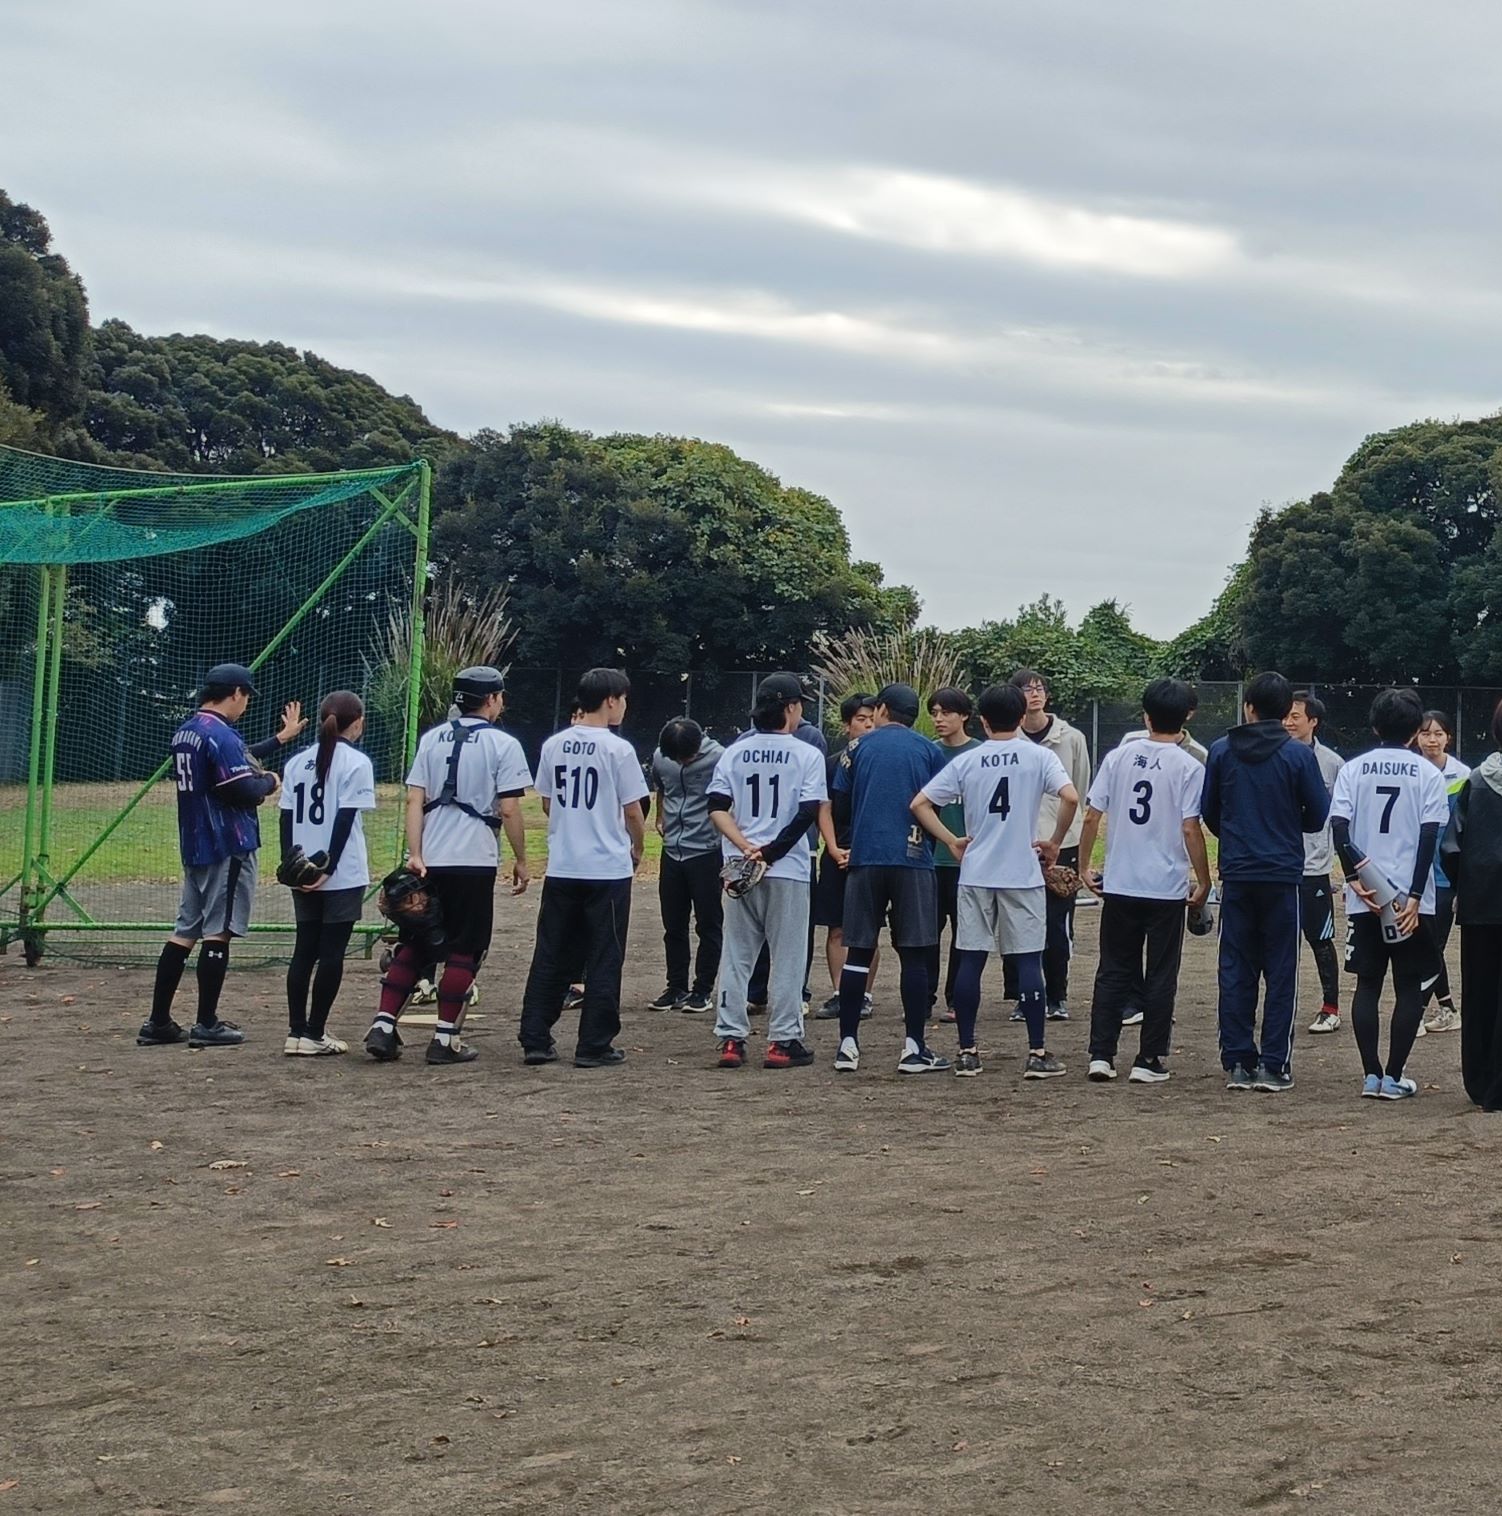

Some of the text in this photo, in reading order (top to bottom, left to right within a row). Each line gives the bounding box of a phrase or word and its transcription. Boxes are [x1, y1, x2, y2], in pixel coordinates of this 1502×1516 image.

[438, 731, 480, 744] KOEI
[562, 740, 596, 756] GOTO
[742, 749, 790, 764] OCHIAI
[981, 752, 1019, 768] KOTA
[1133, 754, 1162, 771] 海人
[1362, 761, 1419, 778] DAISUKE
[555, 765, 599, 811] 510
[746, 773, 779, 819] 11
[988, 776, 1011, 822] 4
[1129, 780, 1153, 825] 3
[293, 782, 325, 826] 18
[1375, 786, 1401, 834] 7
